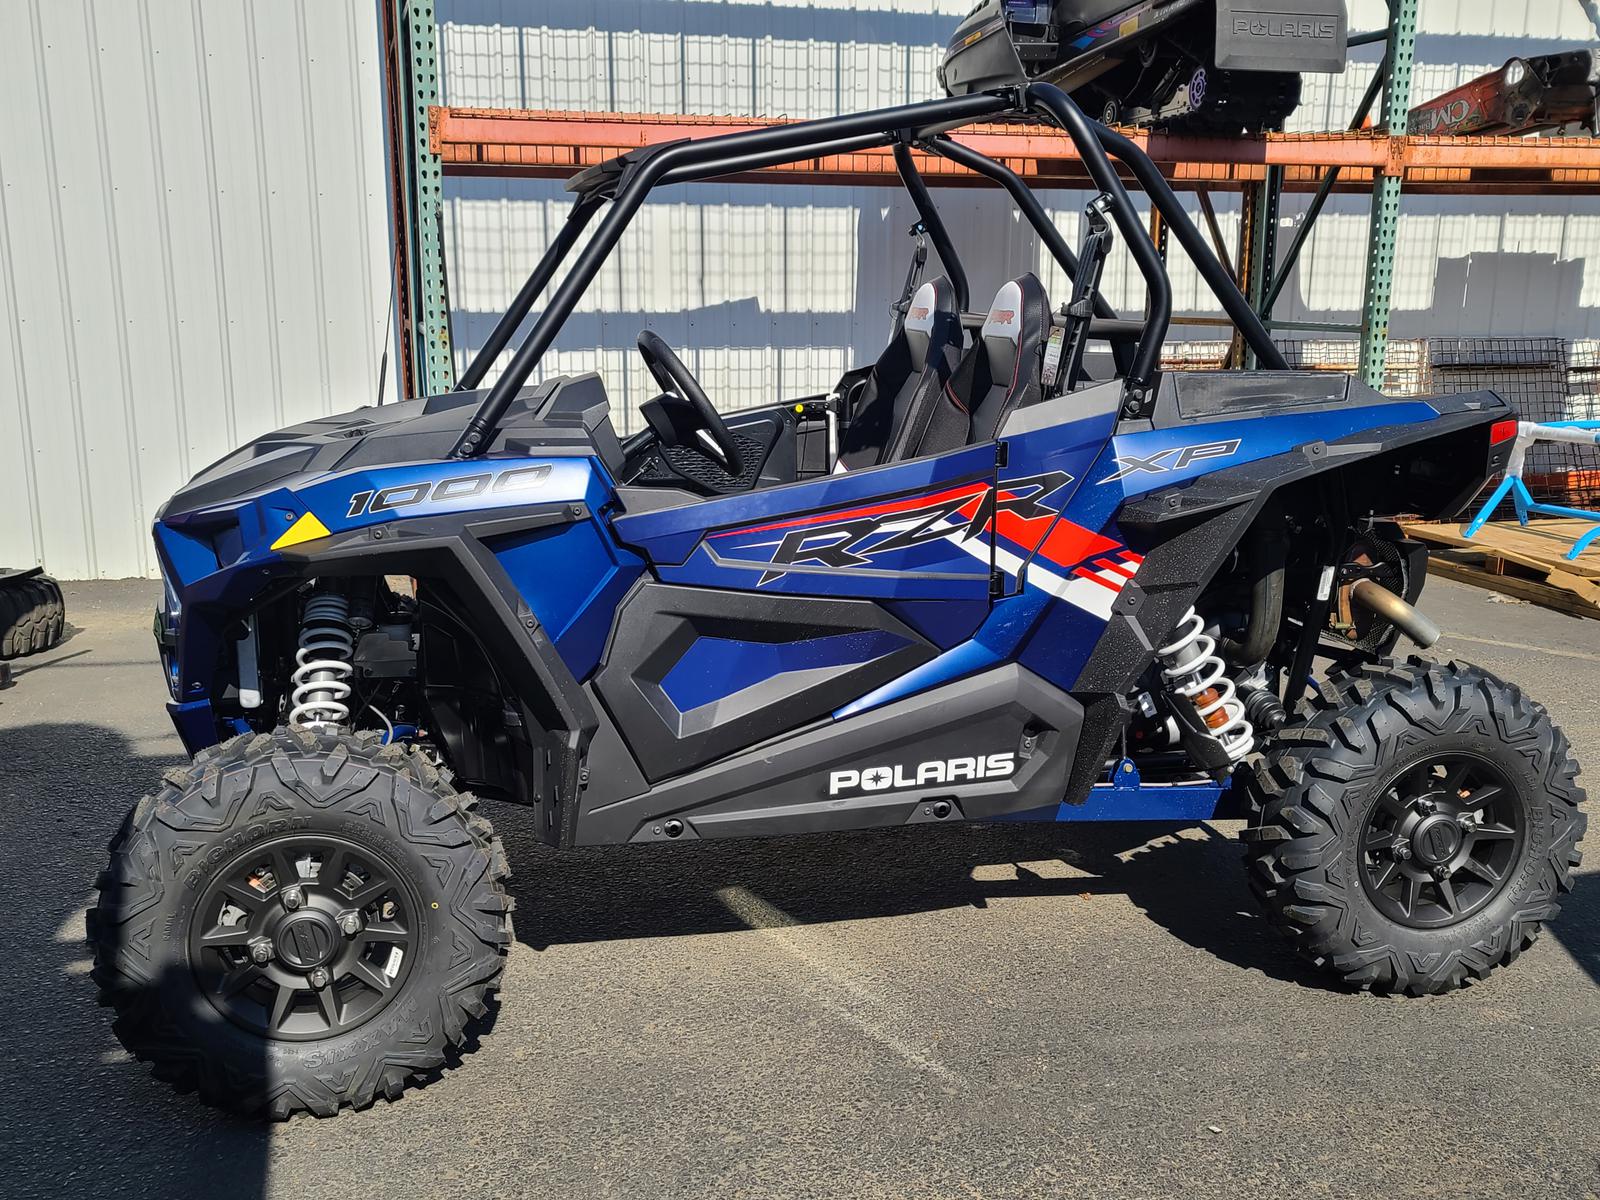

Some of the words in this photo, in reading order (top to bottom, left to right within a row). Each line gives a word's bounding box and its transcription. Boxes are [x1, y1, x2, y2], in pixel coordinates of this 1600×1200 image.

[1232, 17, 1336, 39] POLARIS
[1096, 439, 1242, 486] XP
[346, 463, 553, 518] 1000
[756, 469, 1074, 587] RZR
[829, 752, 1014, 795] POLARIS
[184, 815, 313, 889] BIGHORN
[303, 997, 418, 1069] MAXXIS
